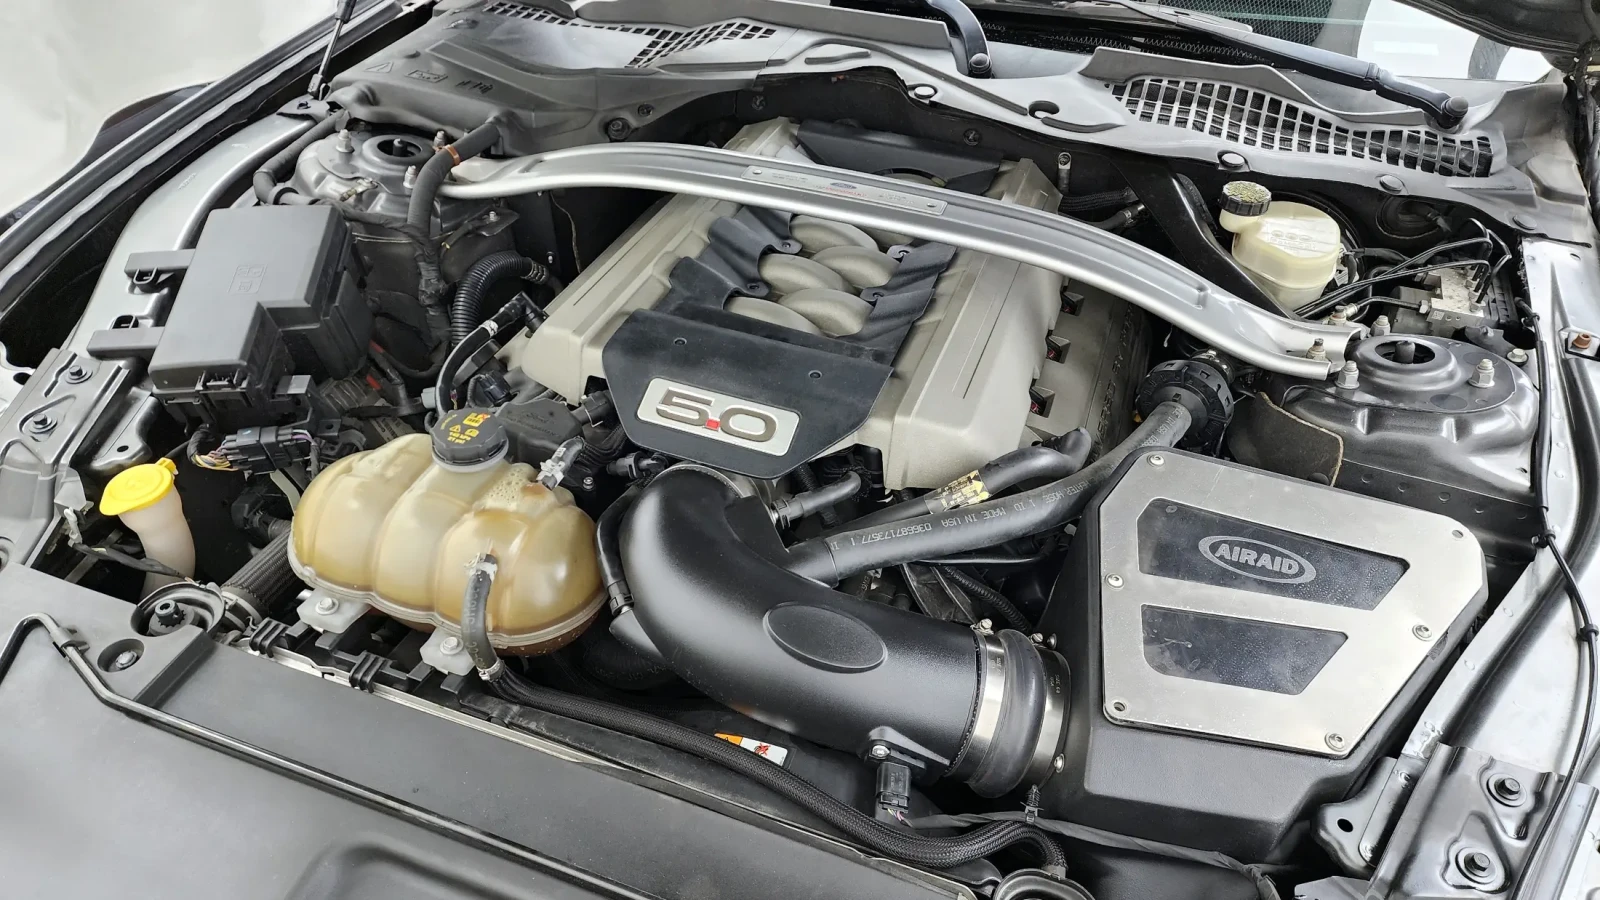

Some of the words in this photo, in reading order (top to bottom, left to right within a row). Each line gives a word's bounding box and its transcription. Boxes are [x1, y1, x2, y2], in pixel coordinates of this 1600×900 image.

[655, 387, 778, 443] 5.0
[1042, 490, 1065, 504] HOSE
[964, 514, 978, 524] IN
[981, 507, 1006, 520] MADE
[941, 518, 961, 527] USA
[861, 522, 932, 544] 036687173577
[1214, 543, 1300, 575] AIRAID
